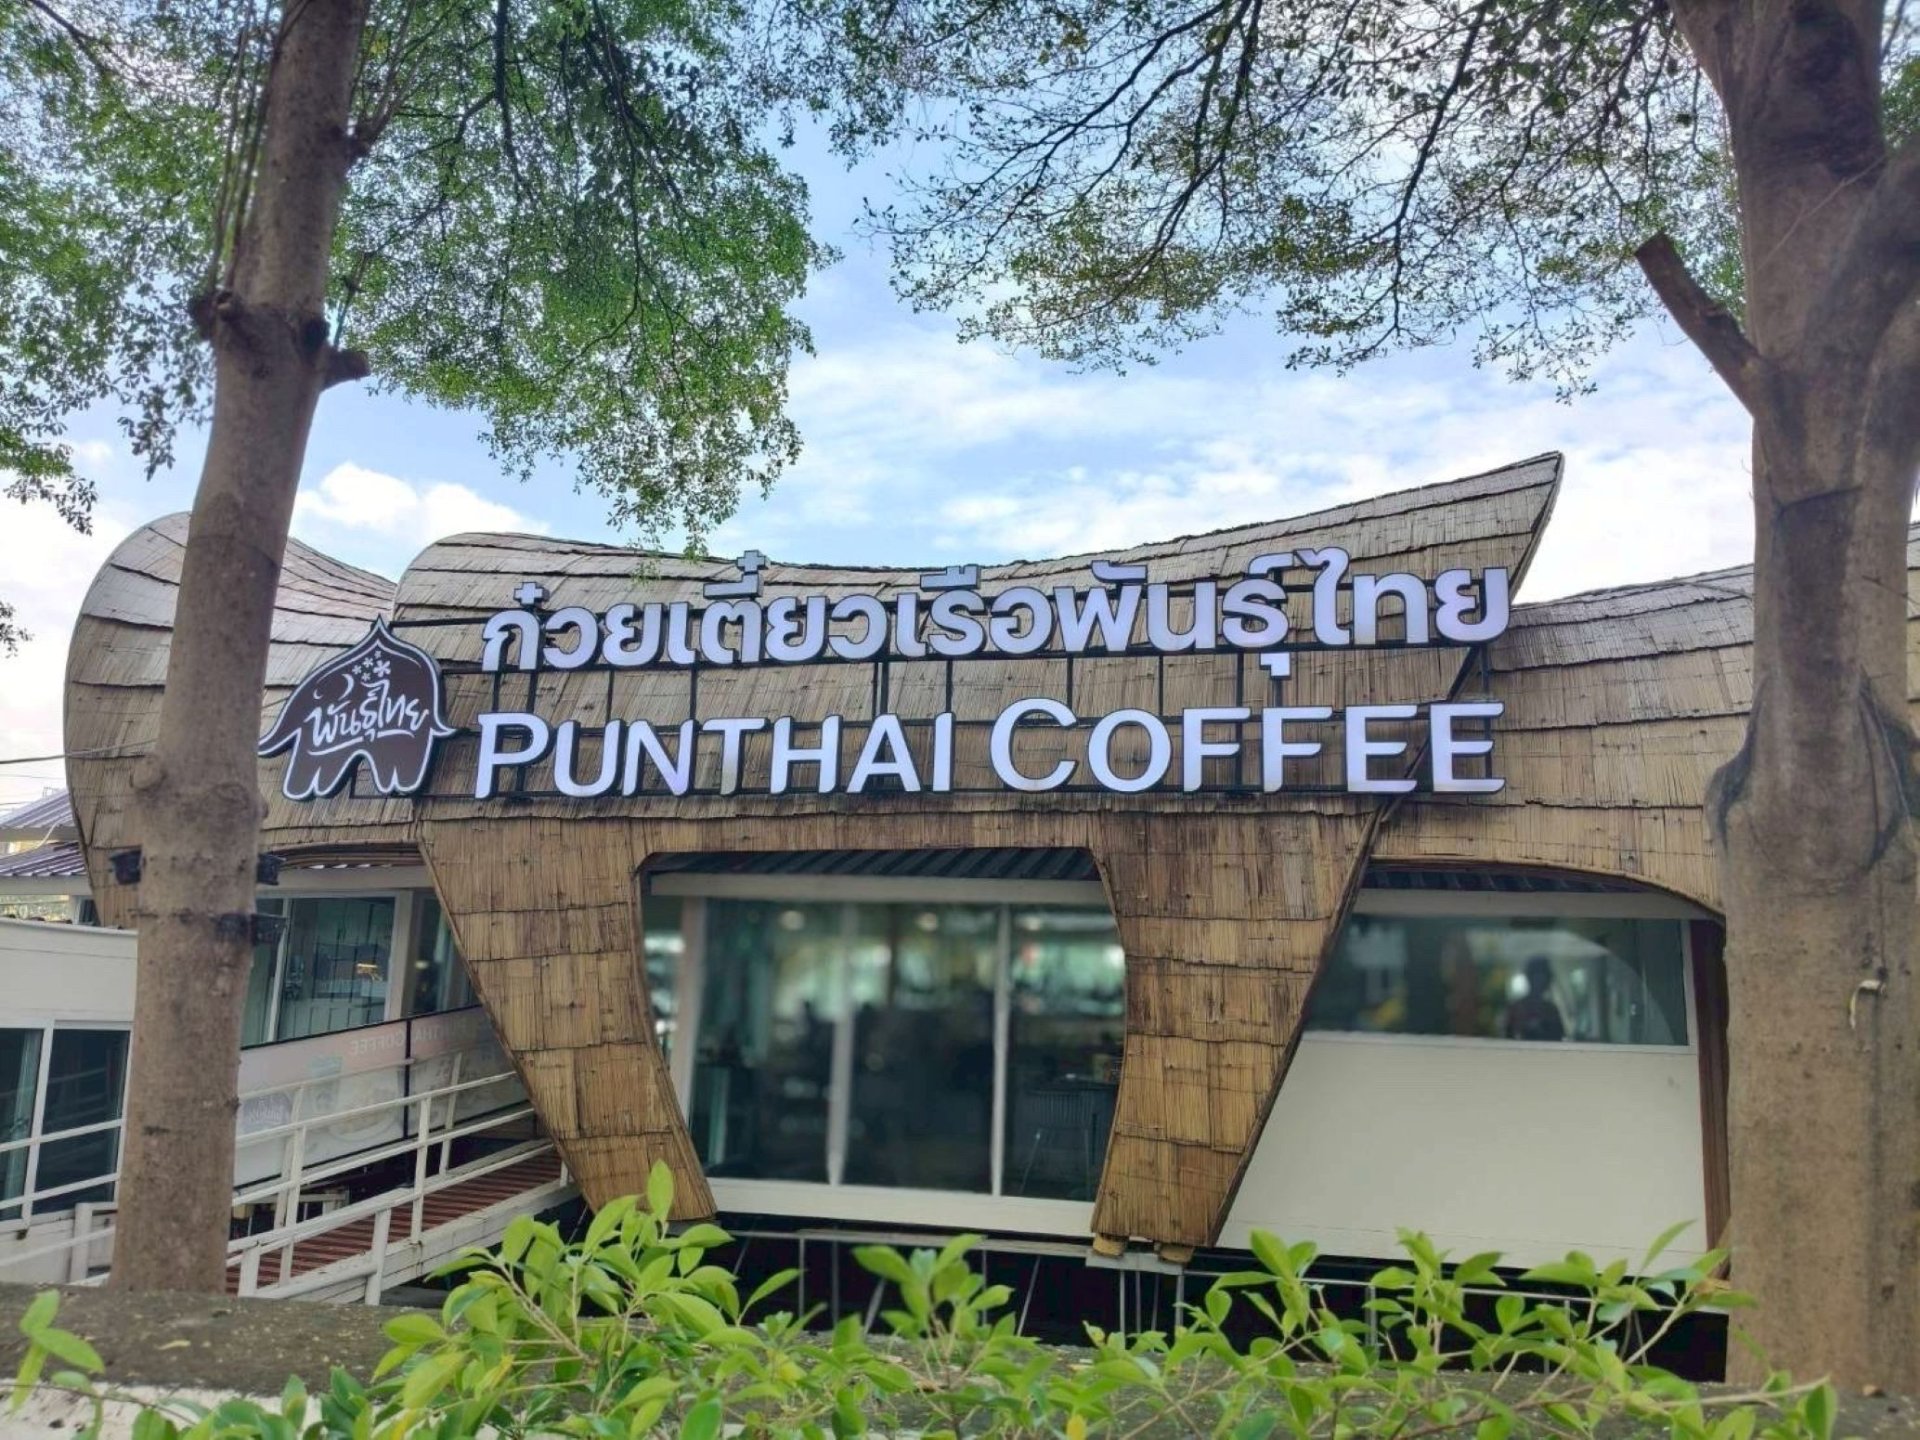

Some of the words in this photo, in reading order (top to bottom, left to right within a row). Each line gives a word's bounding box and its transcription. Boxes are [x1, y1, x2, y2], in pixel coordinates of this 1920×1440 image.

[481, 549, 1511, 678] ก๋วยเตี๋ยวเรือพันธุ์ไทย
[304, 678, 429, 746] พันธุ์ไทย
[475, 711, 955, 800] PUNTHAI
[989, 697, 1506, 794] COFFEE
